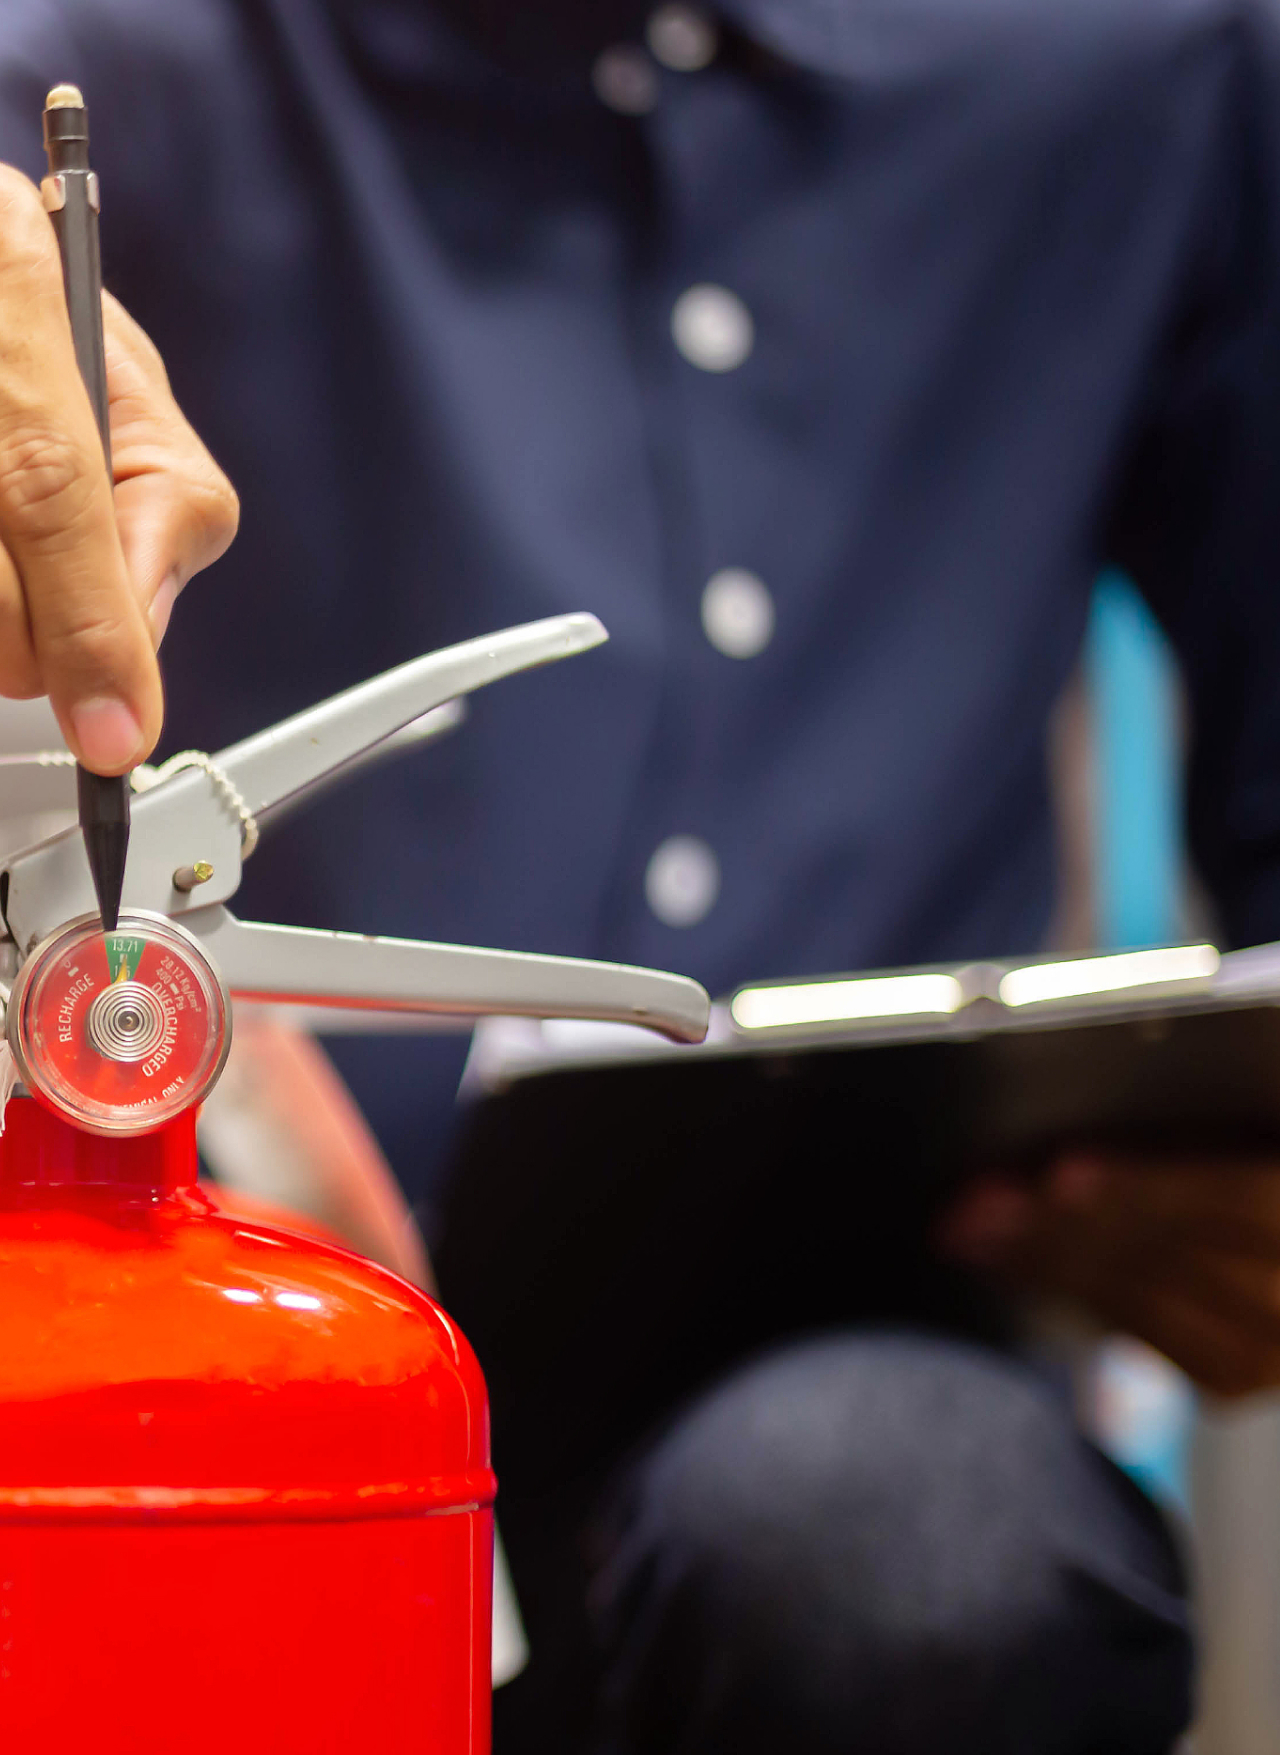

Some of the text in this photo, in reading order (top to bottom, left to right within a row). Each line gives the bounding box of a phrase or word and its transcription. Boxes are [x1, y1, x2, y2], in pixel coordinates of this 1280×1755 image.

[113, 938, 138, 952] 13.71
[58, 973, 95, 1042] RECHARGE
[142, 982, 178, 1077] OVERCHARGED
